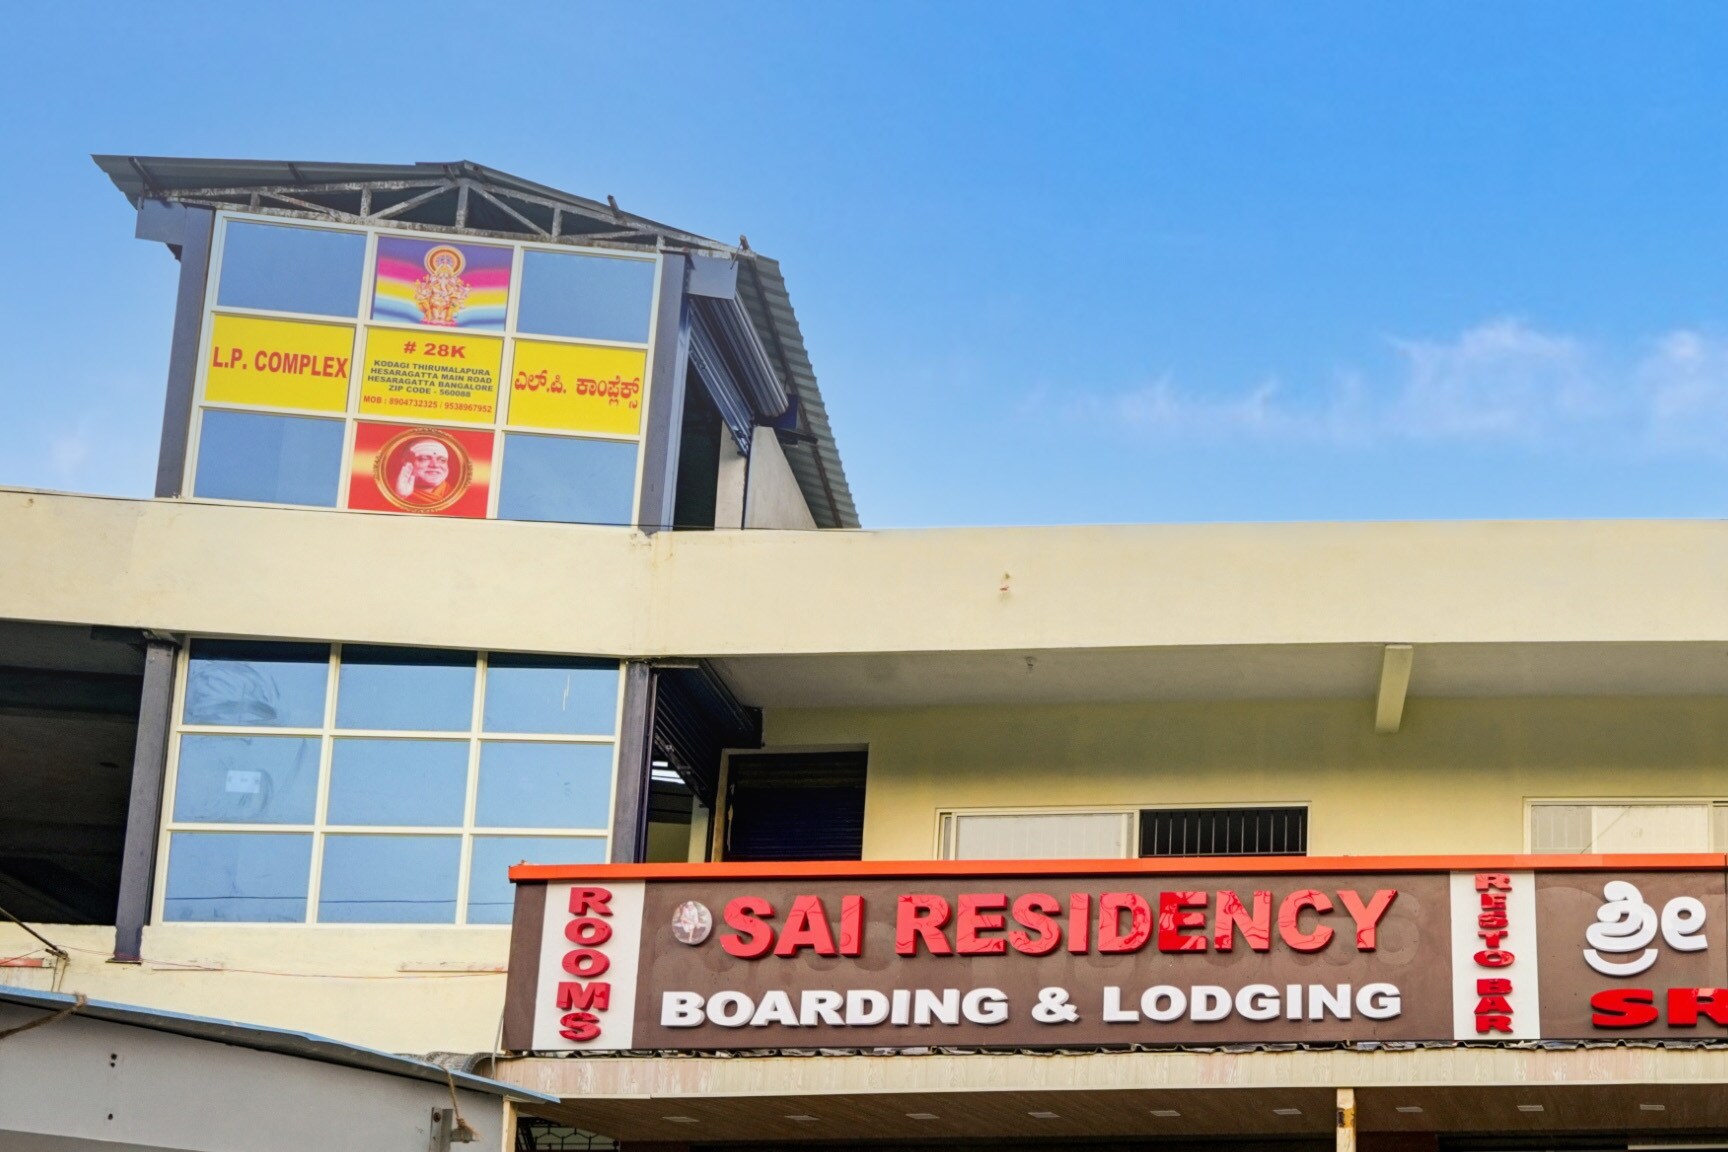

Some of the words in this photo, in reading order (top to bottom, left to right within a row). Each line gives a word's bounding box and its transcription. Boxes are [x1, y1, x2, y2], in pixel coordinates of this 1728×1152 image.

[213, 346, 248, 370] L.P.
[254, 350, 349, 379] COMPLEX
[373, 359, 410, 369] KODAGI
[412, 363, 491, 376] THIRUMALAPURA
[424, 342, 466, 359] 28K
[367, 375, 436, 387] HESARAGATTA
[438, 381, 493, 392] BANGALORE
[370, 367, 439, 380] HESARAGATTA
[441, 374, 465, 382] MAIN
[467, 375, 493, 384] ROAD
[388, 384, 404, 392] ZIP
[406, 385, 431, 395] CODE
[719, 895, 865, 960] SAI
[894, 889, 1398, 957] RESIDENCY
[1473, 873, 1515, 968] RESTO
[1583, 879, 1709, 977] ಶ್ರೀ
[556, 886, 614, 1043] ROOMS
[660, 987, 1009, 1028] BOARDING
[1032, 986, 1080, 1024] &
[1103, 982, 1402, 1023] LODGING
[1473, 978, 1514, 1034] BAR
